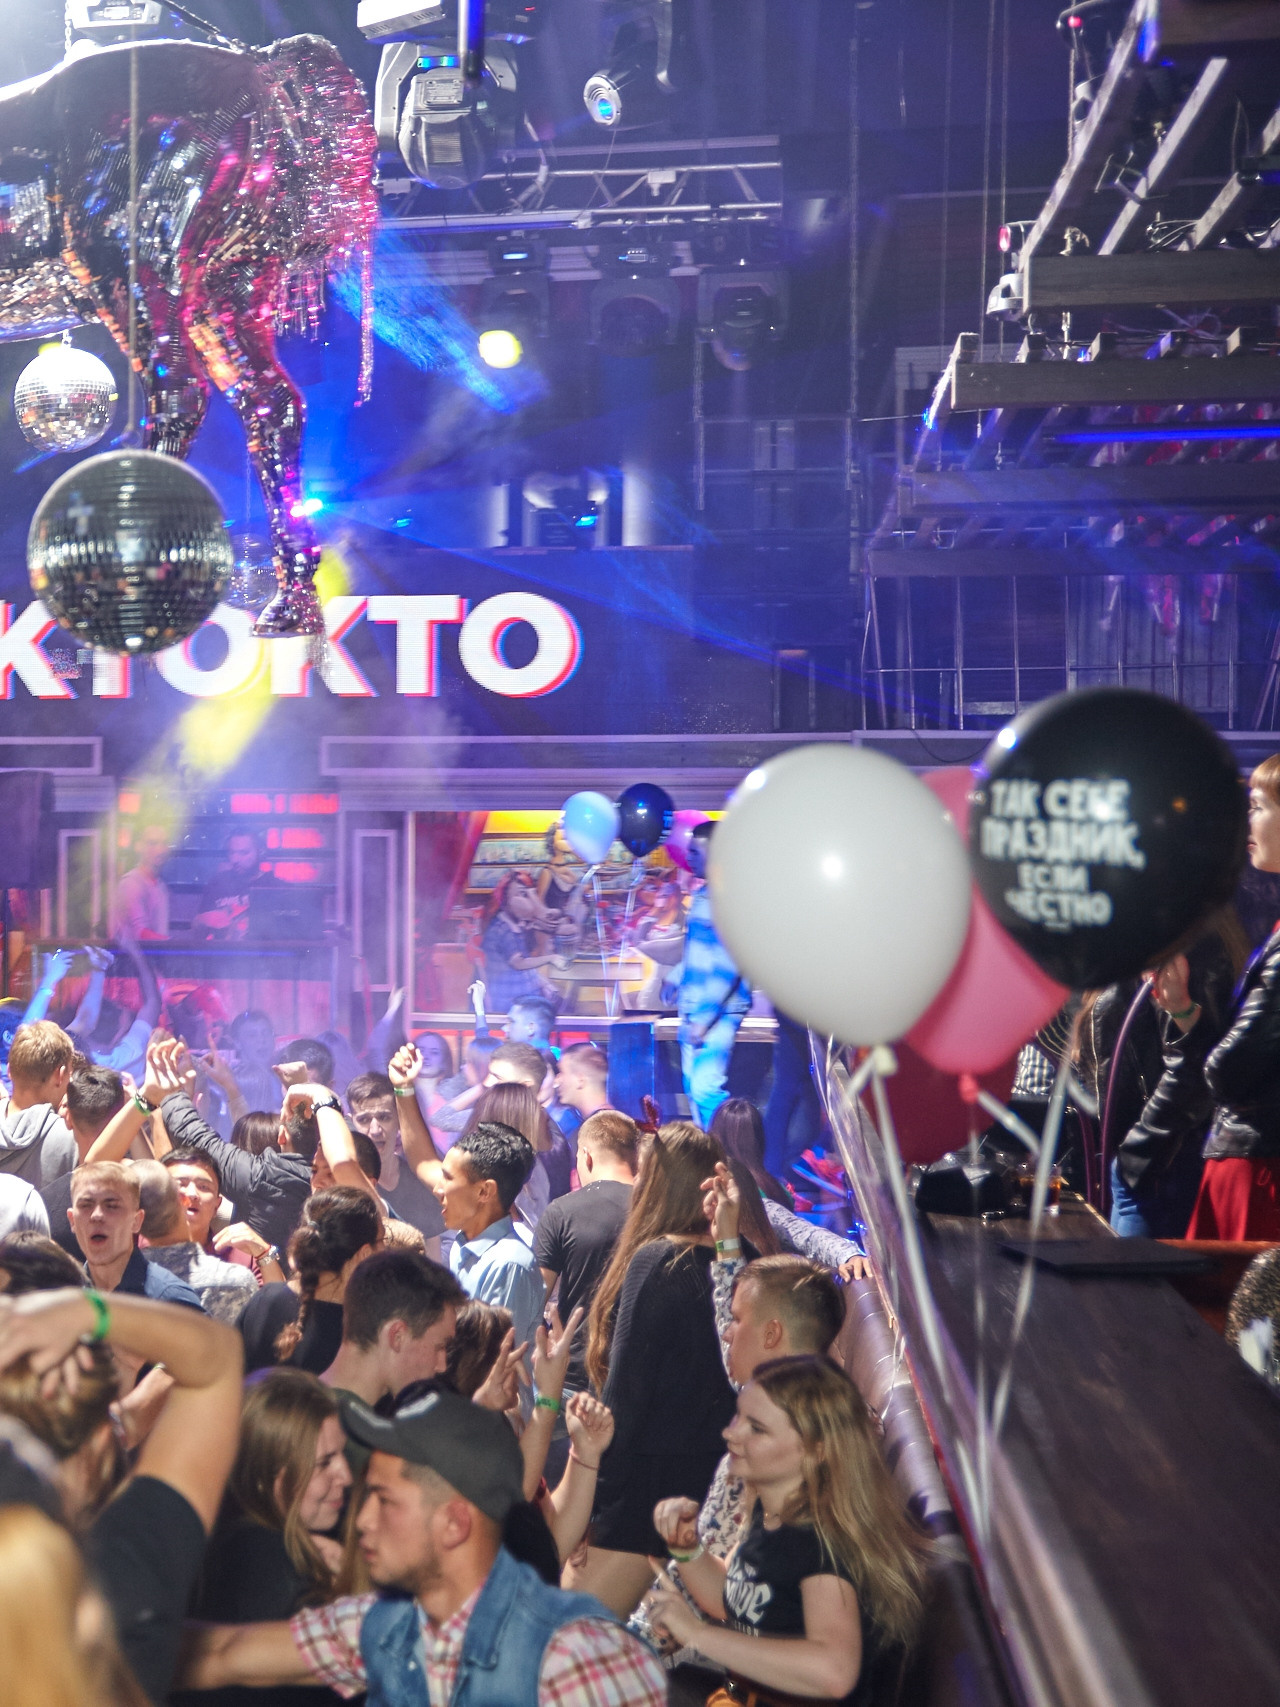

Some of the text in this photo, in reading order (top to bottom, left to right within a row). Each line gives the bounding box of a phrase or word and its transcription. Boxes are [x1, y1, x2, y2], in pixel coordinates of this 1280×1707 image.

[991, 779, 1130, 821] ТАК СЕБЕ
[982, 818, 1146, 869] ПРАЗДНИК,
[1018, 863, 1088, 891] ЕСЛИ
[1005, 889, 1112, 925] ЧЕСТНО
